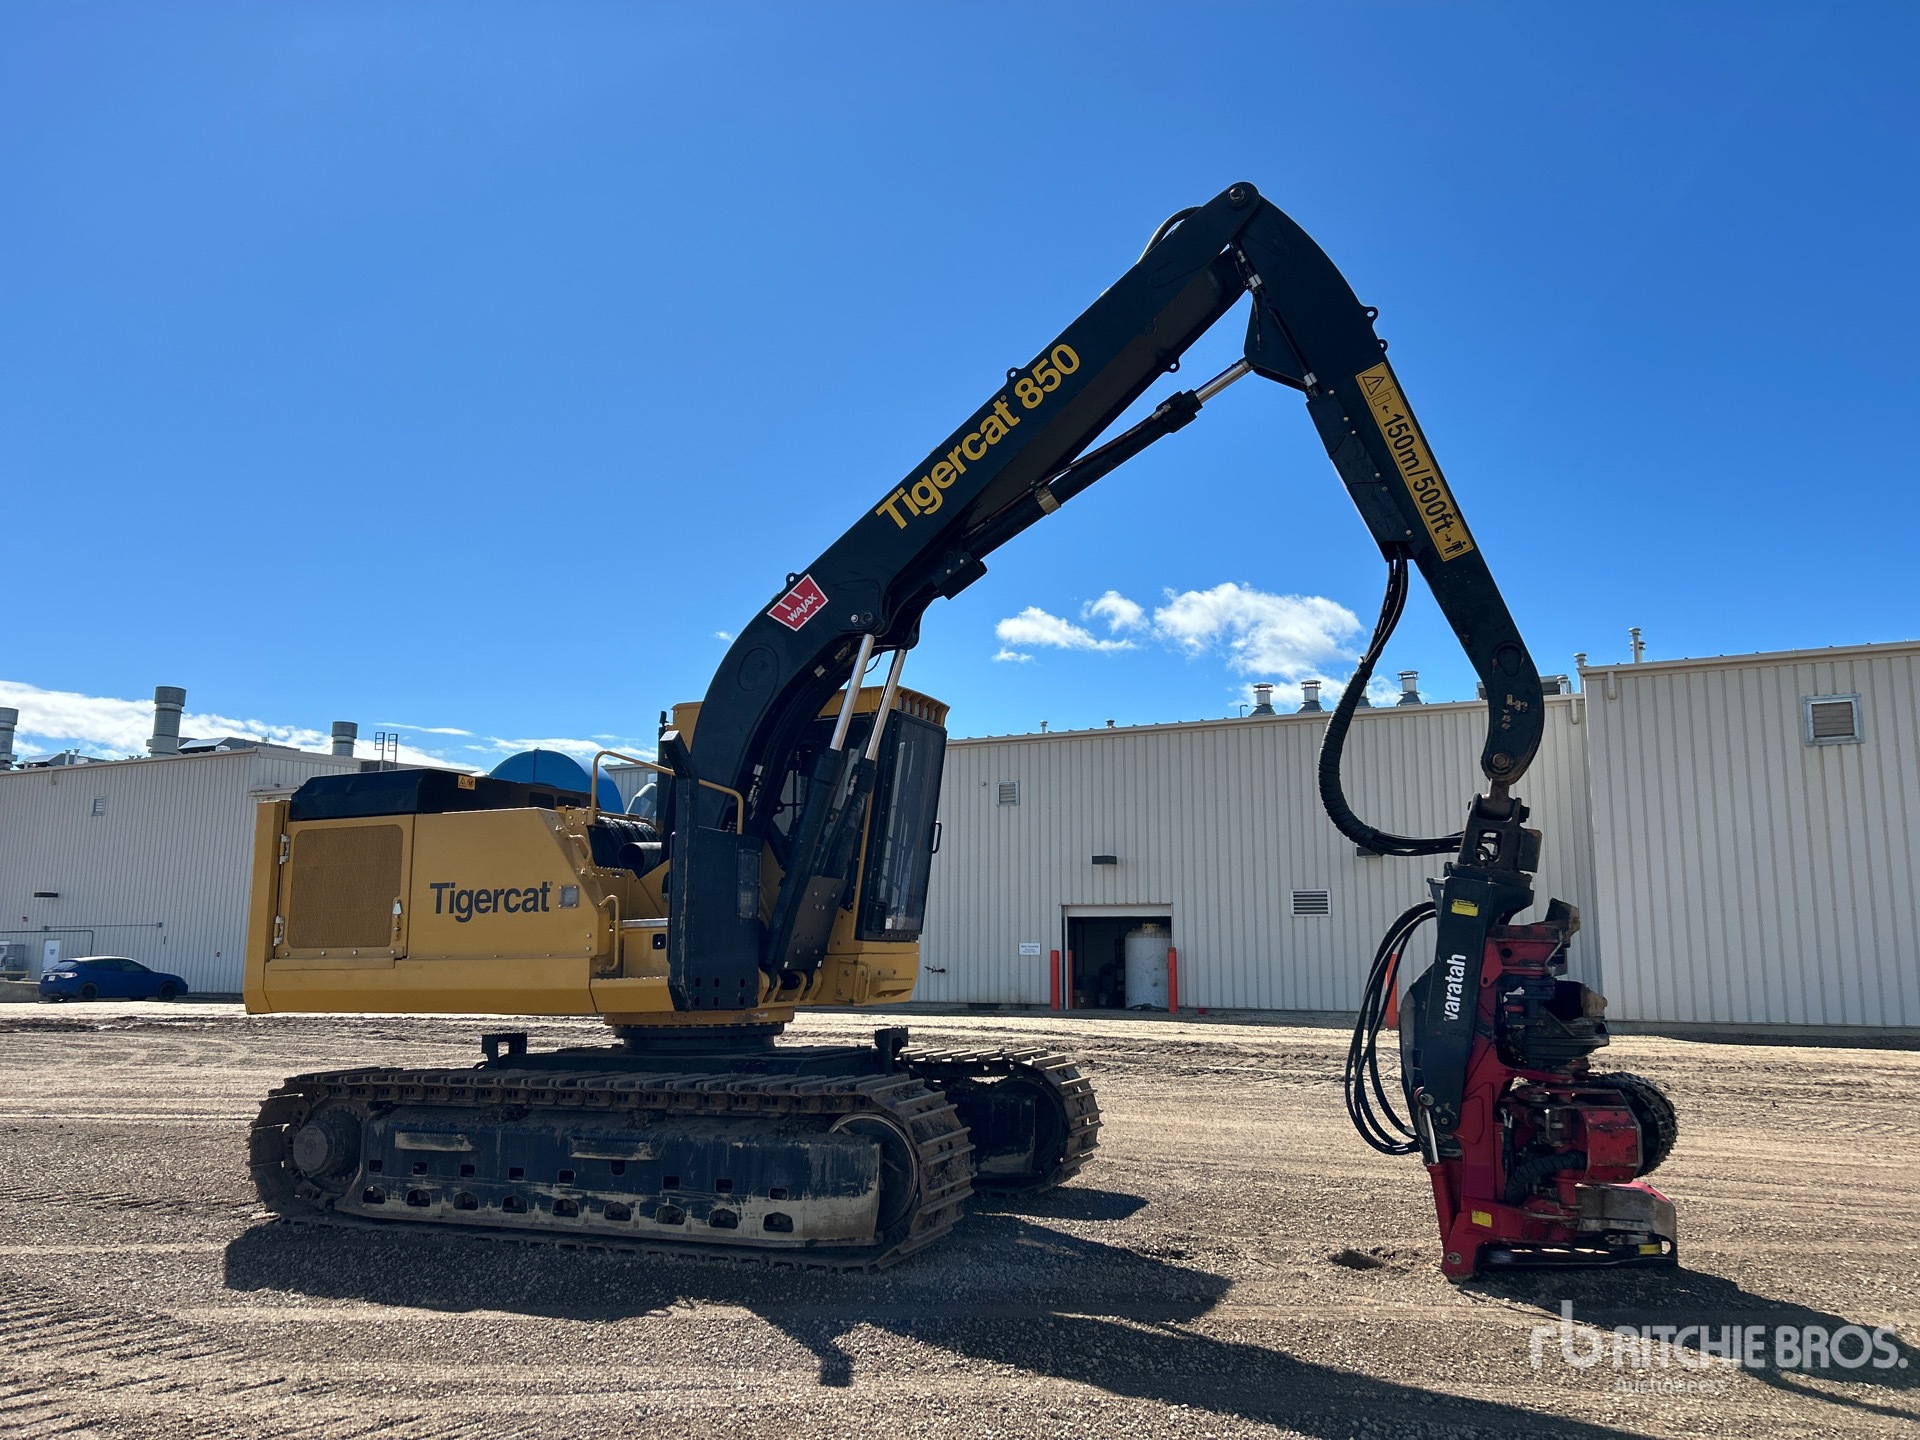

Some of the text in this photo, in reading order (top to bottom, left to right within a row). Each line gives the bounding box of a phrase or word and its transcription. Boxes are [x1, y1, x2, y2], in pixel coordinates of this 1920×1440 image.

[875, 344, 1080, 530] Tigercat 850
[787, 592, 818, 622] WAJAX
[429, 881, 551, 923] Tigercat
